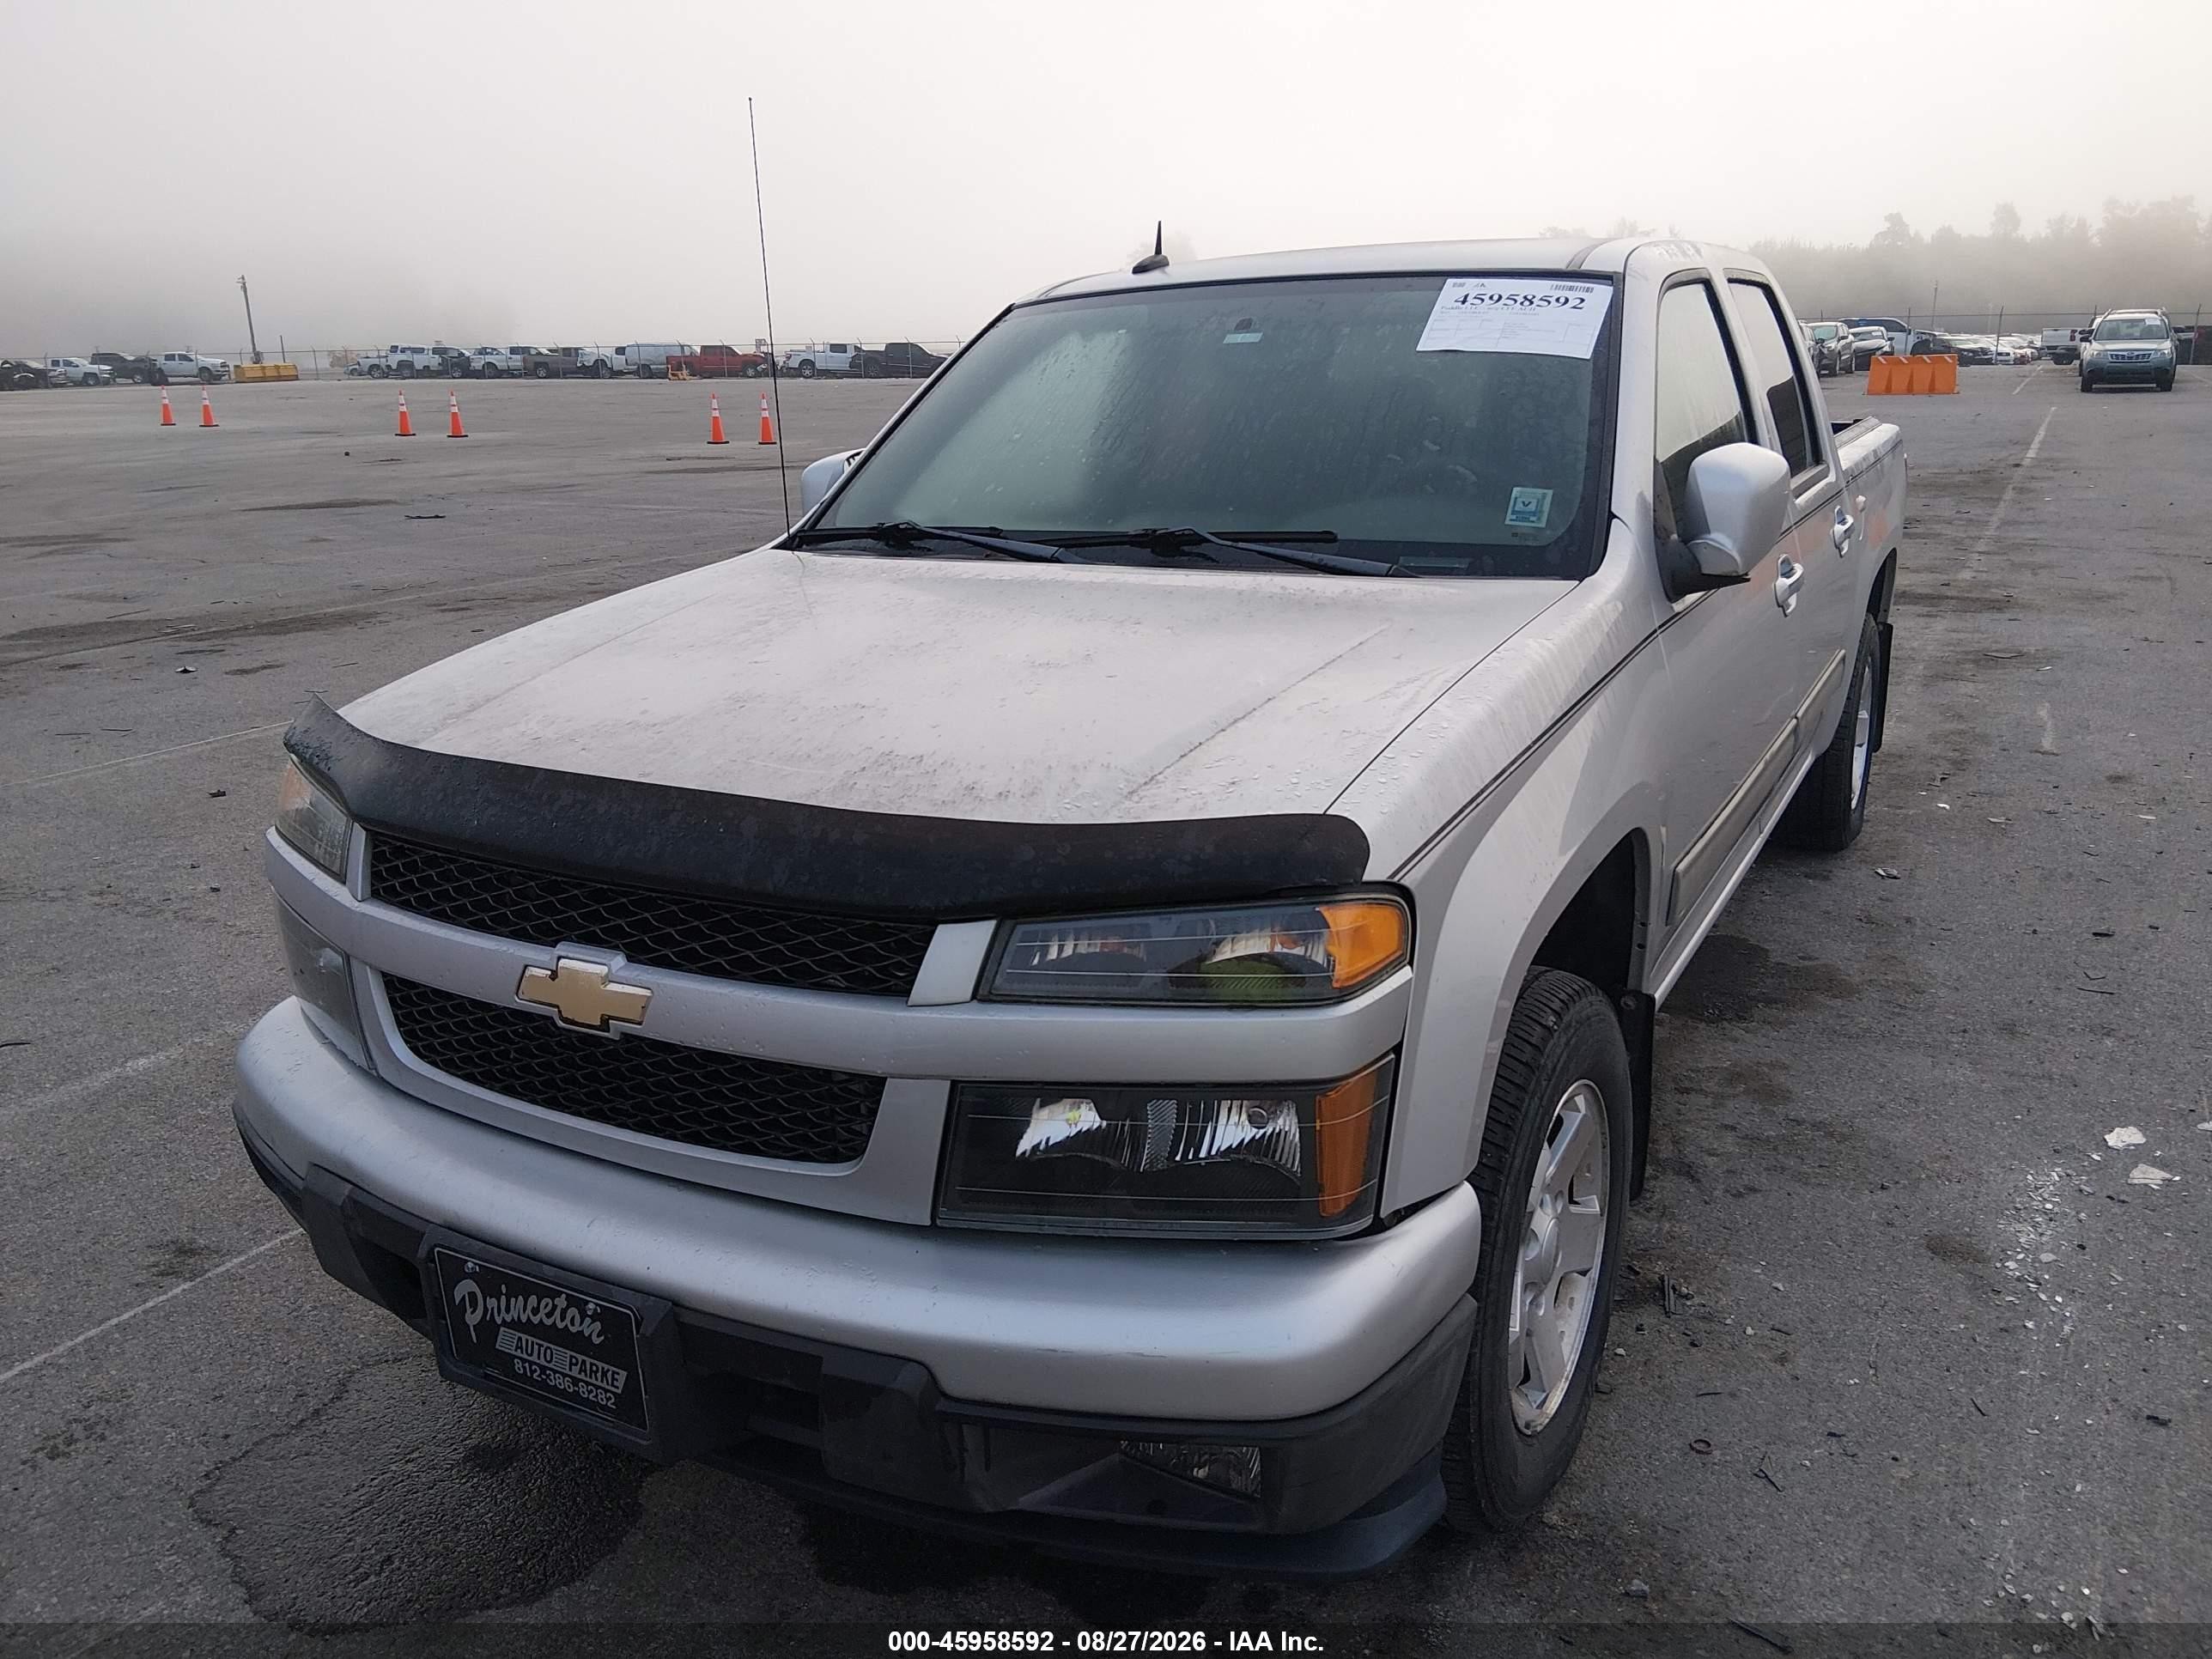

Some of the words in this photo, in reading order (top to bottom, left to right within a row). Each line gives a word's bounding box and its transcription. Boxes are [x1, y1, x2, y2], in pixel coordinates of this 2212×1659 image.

[1454, 292, 1586, 310] 45958592
[453, 1279, 605, 1345] Princeton
[514, 1358, 617, 1409] 812-386-8282
[515, 1334, 554, 1364] AUTO
[568, 1353, 620, 1389] PARKE
